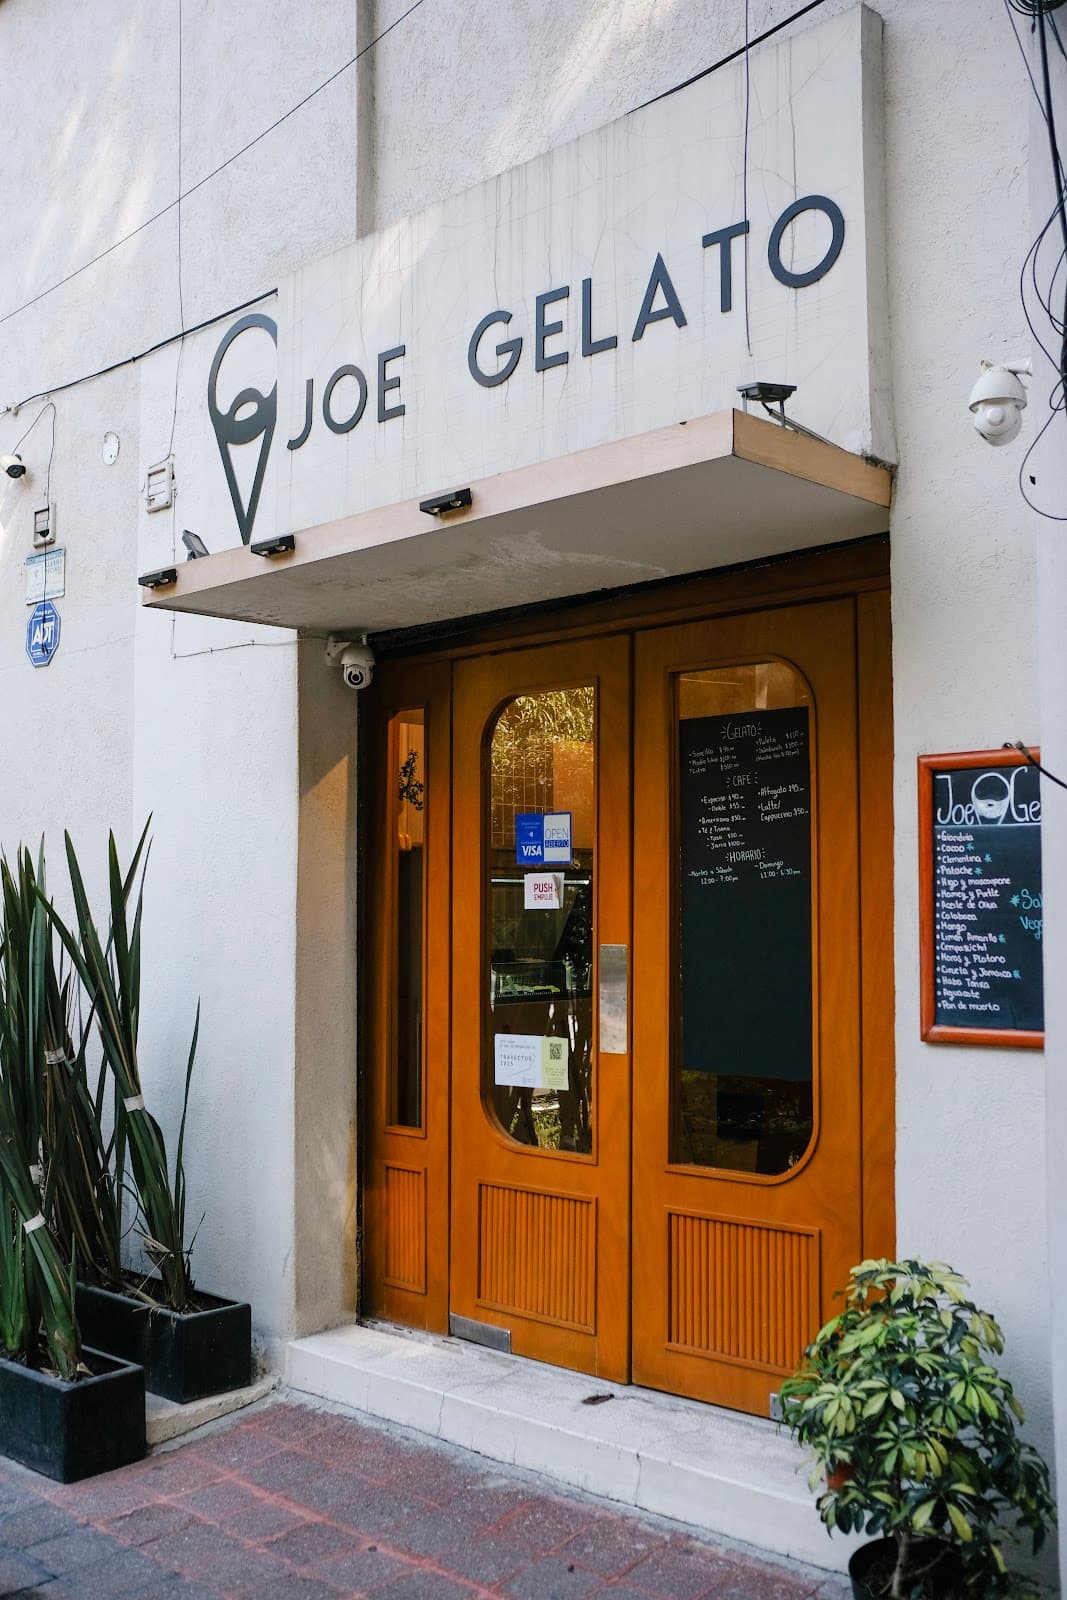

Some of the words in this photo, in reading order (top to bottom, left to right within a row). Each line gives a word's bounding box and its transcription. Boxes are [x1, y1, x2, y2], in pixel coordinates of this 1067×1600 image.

[287, 344, 406, 451] JOE
[467, 194, 846, 389] GELATO
[32, 621, 55, 646] ADT
[726, 722, 757, 740] GELATO
[935, 774, 975, 826] Joe
[544, 828, 569, 839] OPEN
[521, 845, 542, 857] VISA
[729, 848, 762, 864] HORARIO
[759, 860, 784, 871] Domingo
[940, 865, 974, 876] Pistache
[533, 882, 553, 893] PUSH
[966, 900, 976, 909] de
[941, 912, 978, 921] Calabaza
[941, 922, 967, 936] Mango
[941, 1000, 957, 1010] Pan
[957, 1001, 967, 1010] de
[968, 1003, 1001, 1012] muerto
